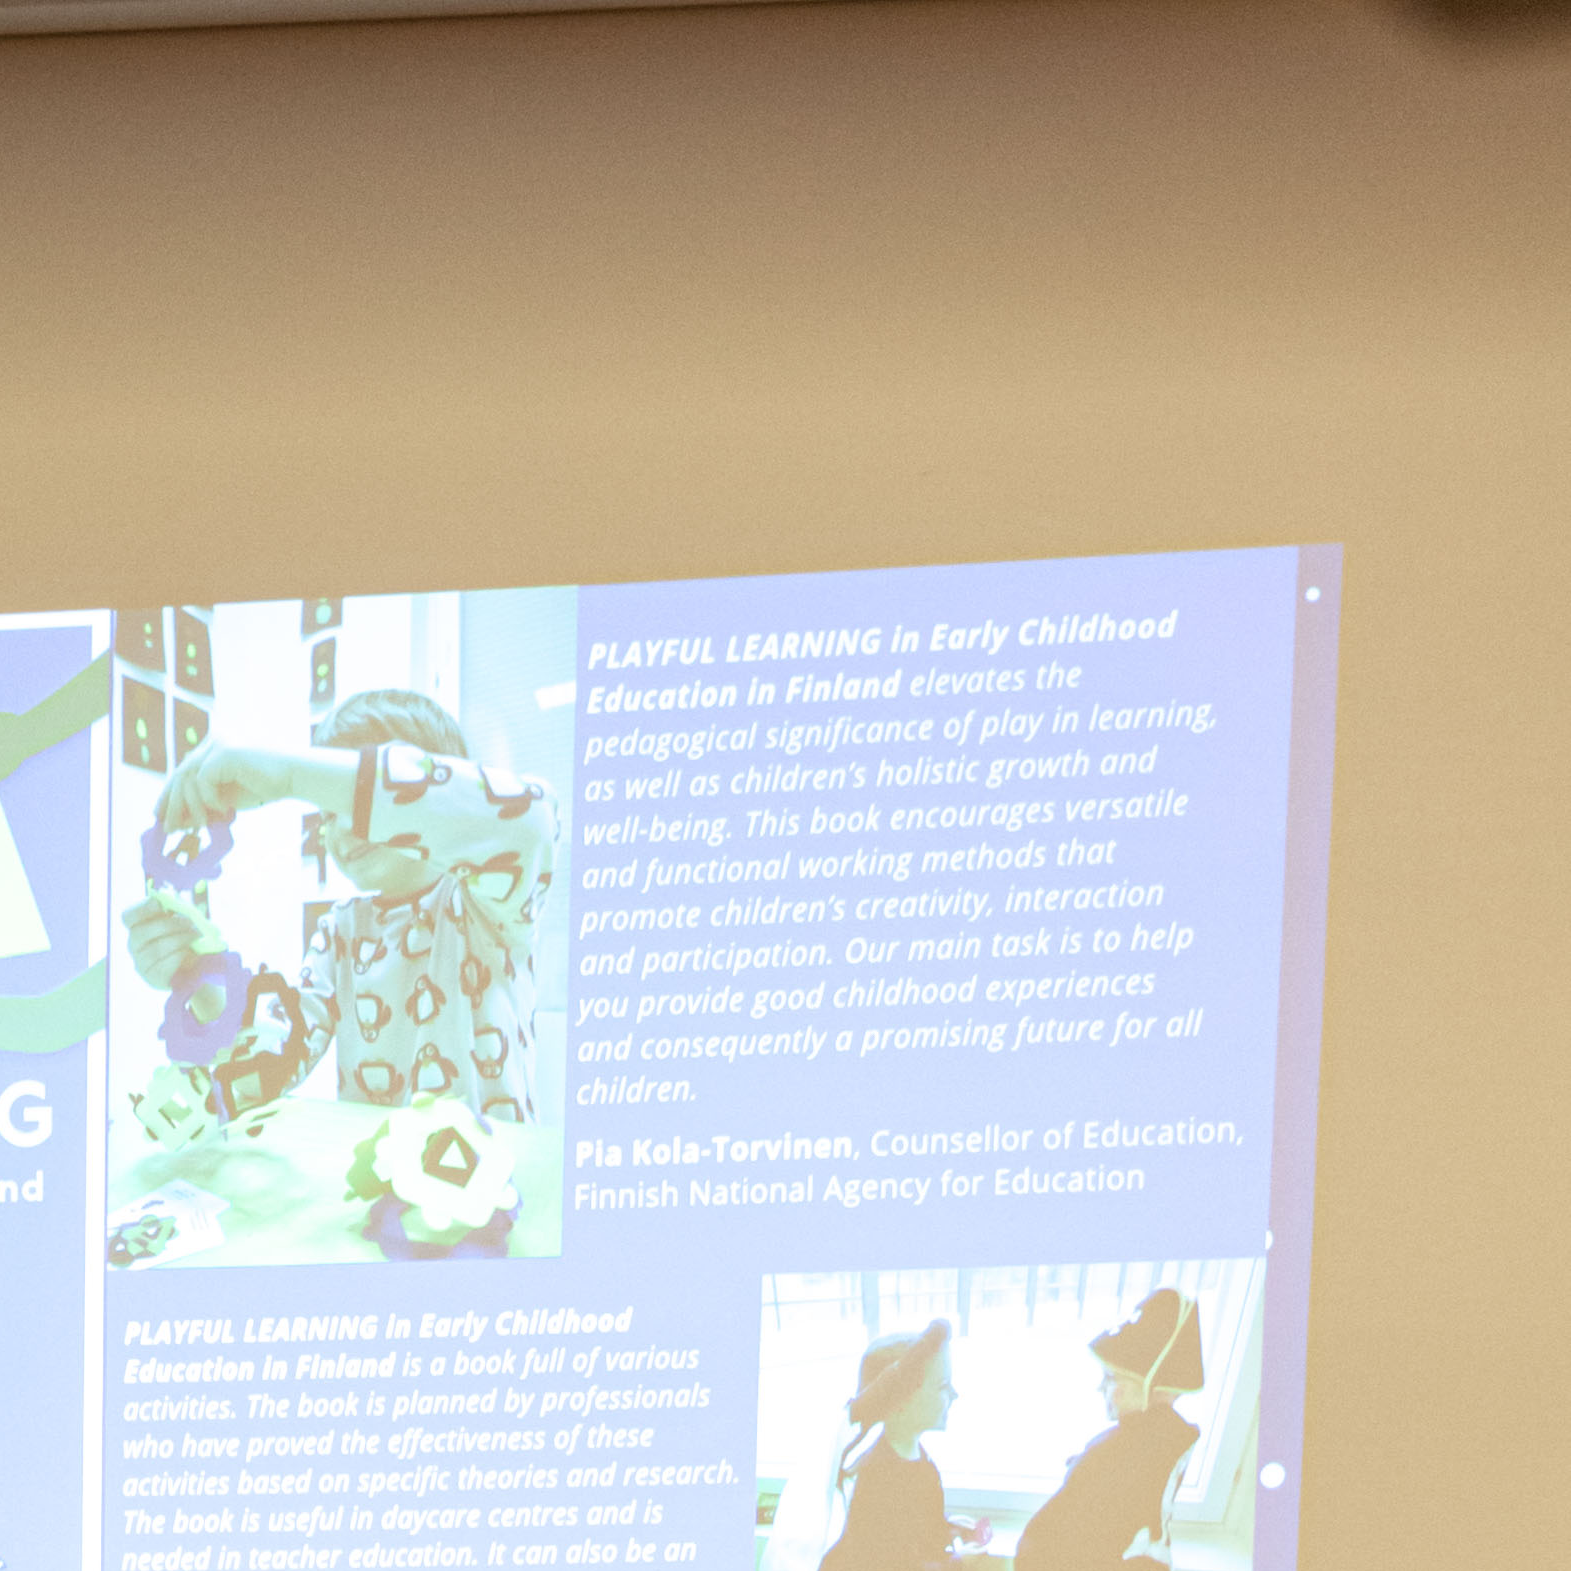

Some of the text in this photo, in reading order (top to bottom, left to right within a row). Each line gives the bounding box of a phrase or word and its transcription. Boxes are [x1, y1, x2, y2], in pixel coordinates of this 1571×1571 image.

[587, 609, 1178, 670] PLAYFUL LEARNING in Early Childhood
[586, 660, 1082, 714] Education in Finland elevates the
[583, 703, 1216, 765] pedagogical significance of play in learning,
[583, 787, 1188, 846] well-being. This book encourages versatile
[582, 837, 1116, 893] and functional working methods that
[578, 903, 701, 940] promote
[855, 887, 992, 922] creativity,
[1004, 879, 1164, 912] interaction
[574, 972, 1155, 1026] you provide good childhood experiences
[576, 1075, 696, 1105] children.
[575, 1119, 1243, 1168] Pia Kola-Torvinen, Counsellor of Education,
[574, 1163, 1144, 1210] Finnish National Agency for Education
[123, 1307, 633, 1345] PLAYFUL LEARNING in Early Childhood
[122, 1382, 710, 1421] activities. The book is planned by professionals
[122, 1459, 739, 1498] activities based on specific theories and research.
[120, 1537, 696, 1571] needed in teacher education. It can also be an
